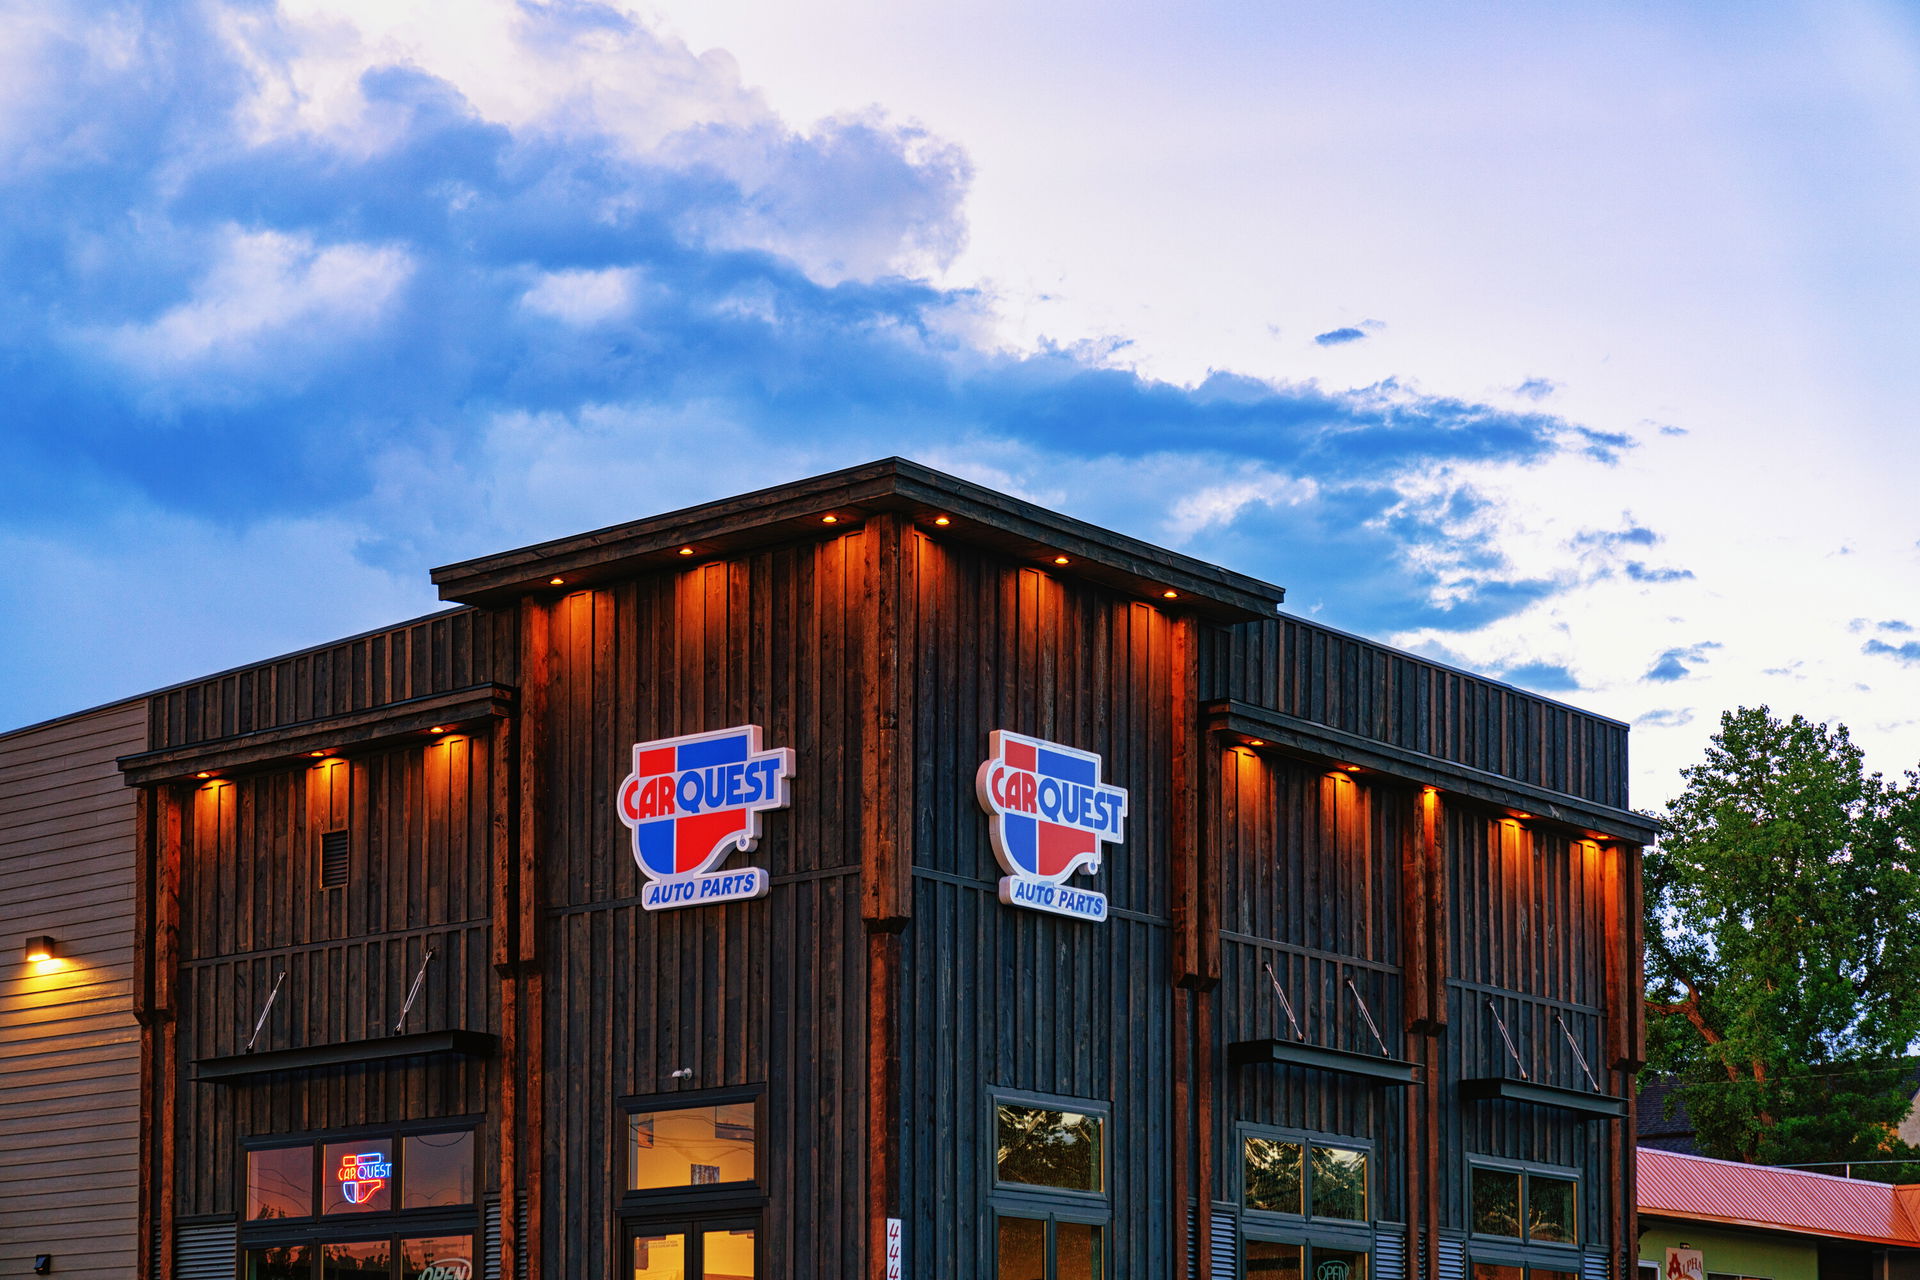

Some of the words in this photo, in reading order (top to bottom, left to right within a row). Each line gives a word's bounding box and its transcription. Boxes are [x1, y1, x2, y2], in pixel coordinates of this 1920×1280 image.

[623, 758, 780, 820] CARQUEST
[991, 767, 1123, 834] CARQUEST
[648, 881, 695, 905] AUTO
[700, 873, 755, 898] PARTS
[1015, 882, 1055, 905] AUTO
[1058, 890, 1103, 916] PARTS
[338, 1163, 392, 1181] CARQUEST
[421, 1265, 468, 1280] OPEN
[1317, 1265, 1348, 1280] OPEN
